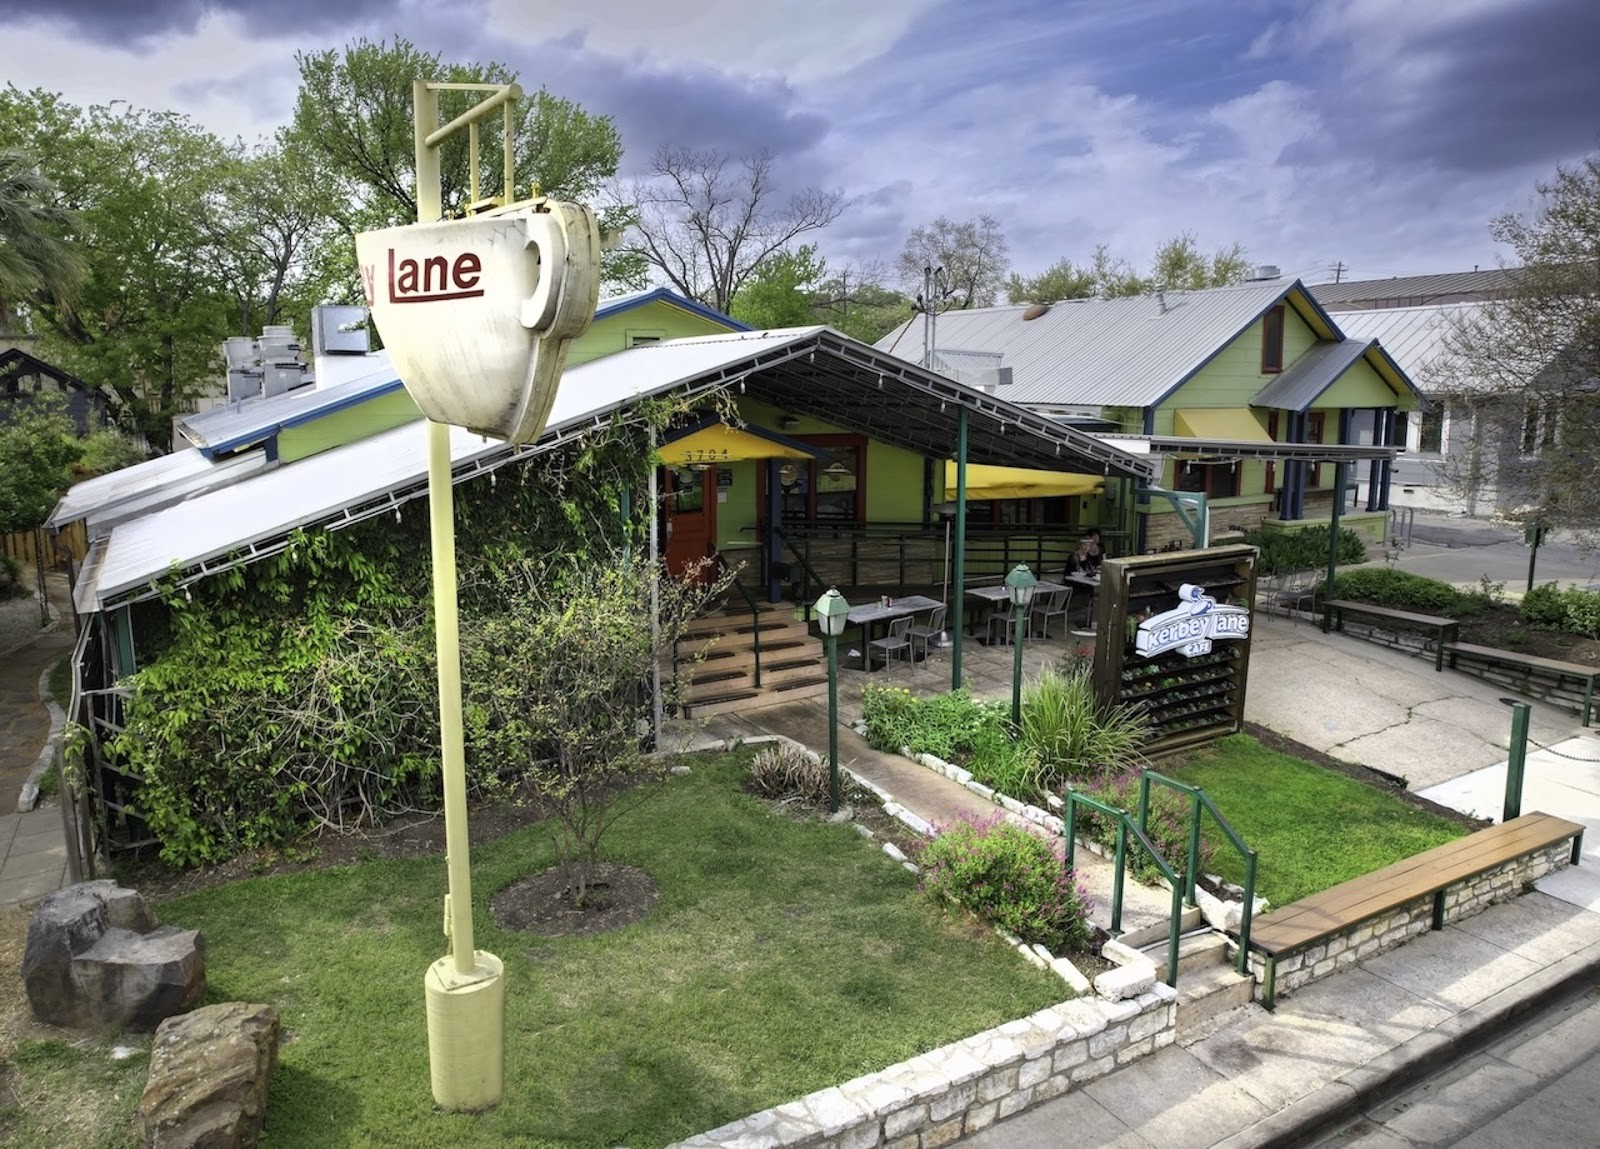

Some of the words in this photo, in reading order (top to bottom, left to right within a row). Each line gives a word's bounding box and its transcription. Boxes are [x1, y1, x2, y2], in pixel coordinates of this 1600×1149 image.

[388, 248, 484, 303] Lane
[685, 449, 728, 462] 3704
[1187, 642, 1210, 655] CAFE
